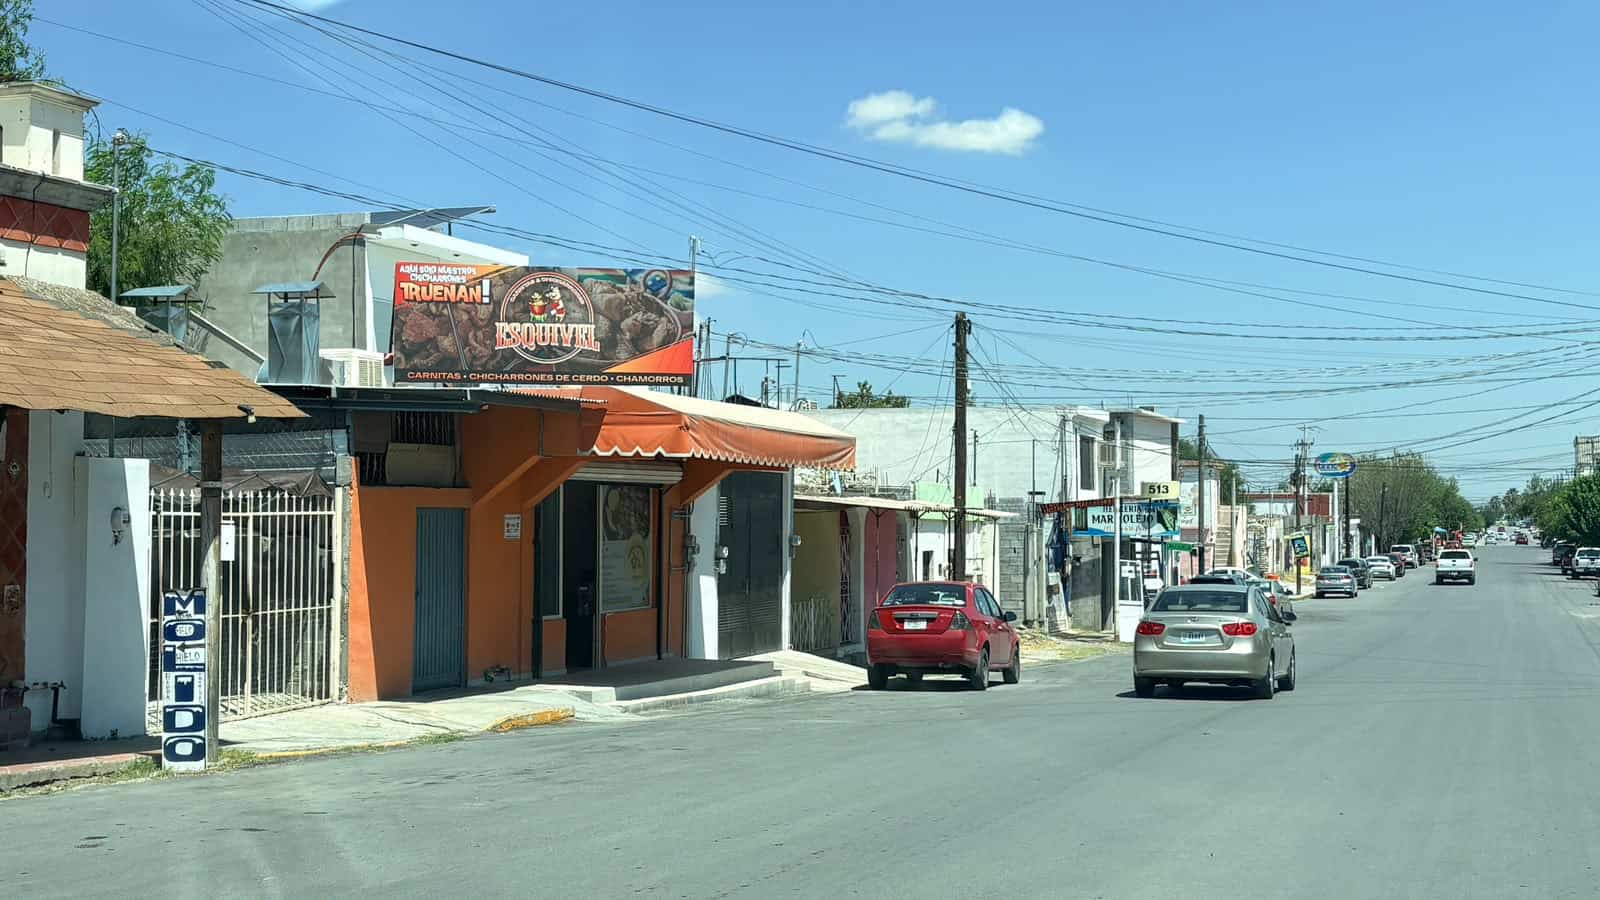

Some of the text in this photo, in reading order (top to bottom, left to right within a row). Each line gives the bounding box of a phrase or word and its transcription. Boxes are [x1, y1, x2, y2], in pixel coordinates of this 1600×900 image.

[400, 279, 491, 304] TRUENAN!
[494, 321, 600, 353] ESQUIVEL
[407, 371, 684, 383] CARNITAS CHICHARRONES DE CERDO CHAMORROS
[1148, 484, 1169, 494] 513
[1092, 514, 1154, 524] MAROLEJO
